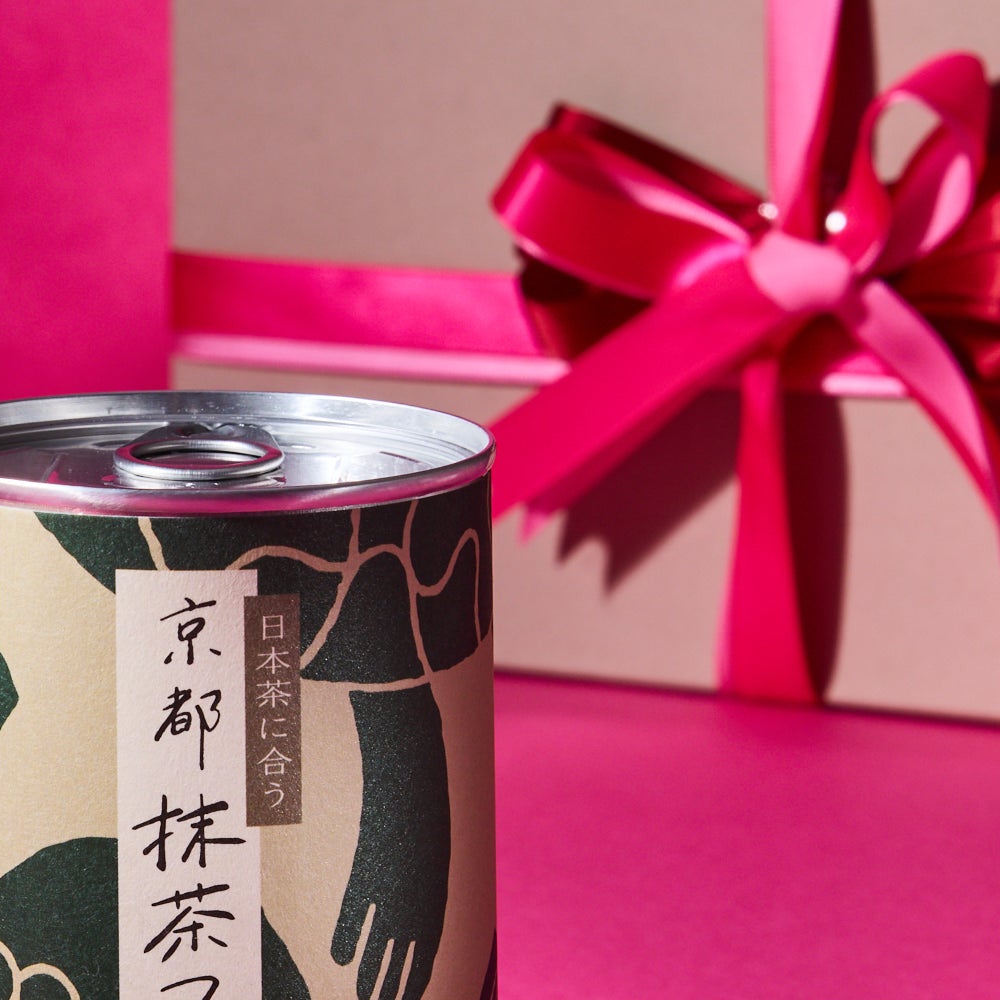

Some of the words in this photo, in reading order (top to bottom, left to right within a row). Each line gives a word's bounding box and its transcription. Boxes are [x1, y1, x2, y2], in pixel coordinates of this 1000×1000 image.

[255, 613, 293, 808] 日本茶に合う
